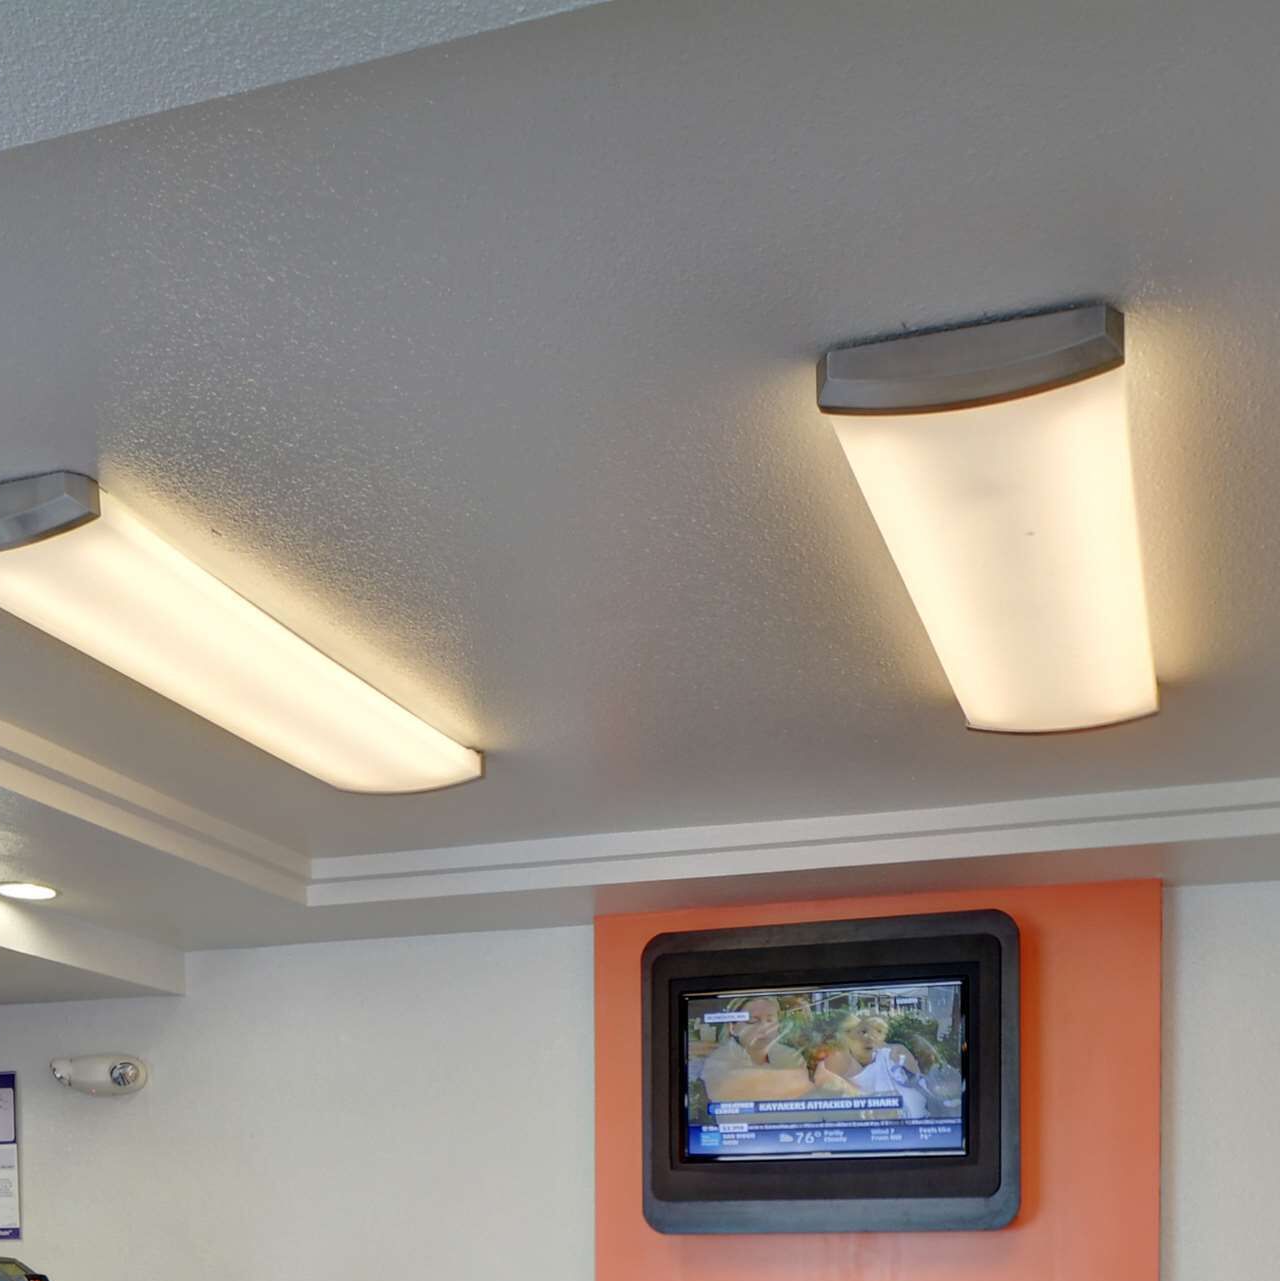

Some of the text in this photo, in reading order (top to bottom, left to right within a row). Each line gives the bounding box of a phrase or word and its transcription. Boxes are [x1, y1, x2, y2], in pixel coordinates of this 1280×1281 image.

[759, 1098, 900, 1112] KAYAKERS ATTACKED BY SHARK
